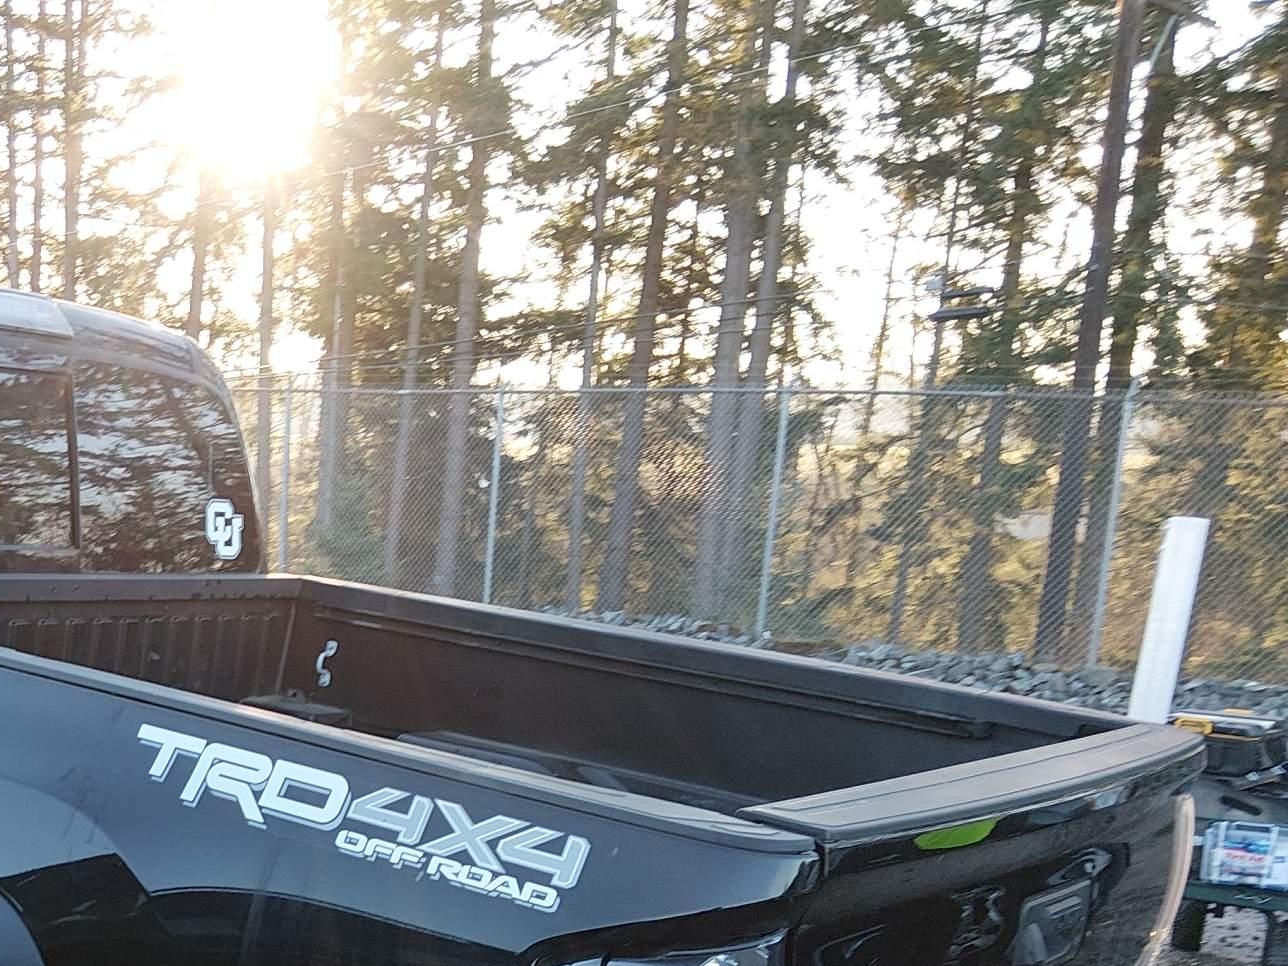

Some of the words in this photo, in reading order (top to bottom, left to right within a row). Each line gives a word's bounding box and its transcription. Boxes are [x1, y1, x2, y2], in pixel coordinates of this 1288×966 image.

[136, 723, 352, 831] TRD
[334, 829, 426, 870] OFF
[426, 855, 560, 914] ROAD
